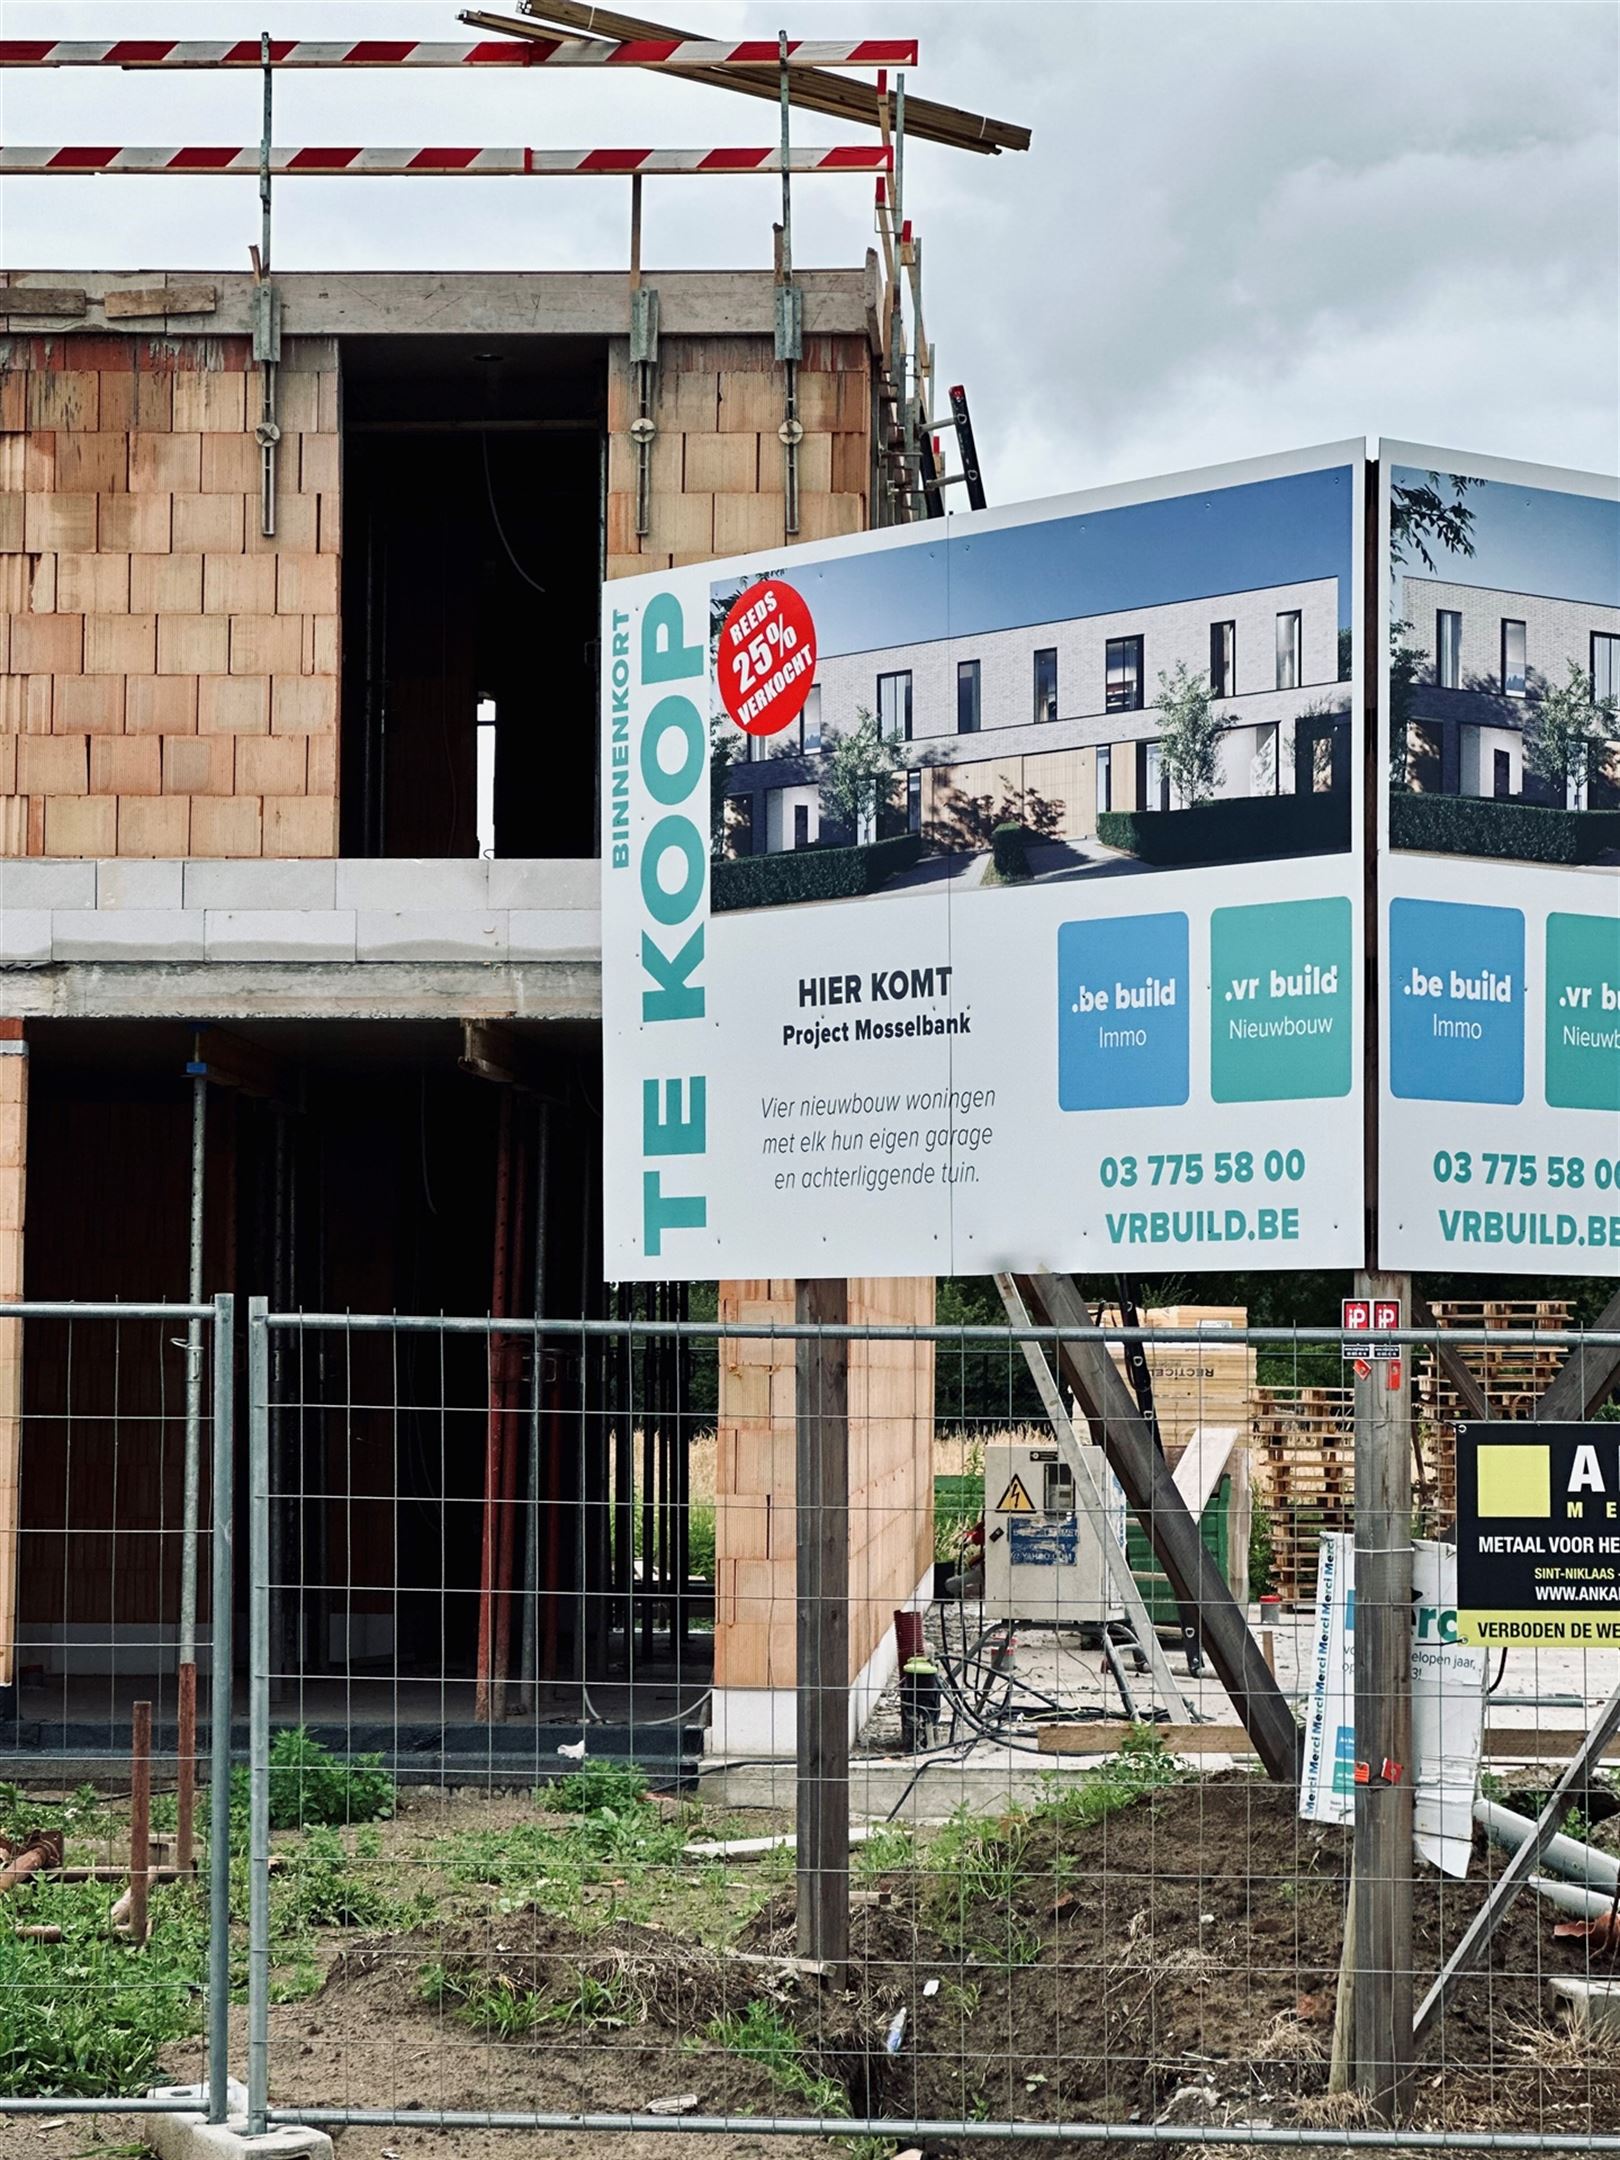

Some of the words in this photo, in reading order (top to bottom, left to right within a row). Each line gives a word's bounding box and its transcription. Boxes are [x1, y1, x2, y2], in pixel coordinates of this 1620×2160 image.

[729, 589, 778, 647] REEDS
[732, 614, 797, 696] 25%
[737, 642, 814, 726] VERKOCHT
[612, 609, 630, 870] BINNENKORT
[640, 592, 706, 1023] KOOP
[799, 974, 862, 1007] HIER
[871, 966, 952, 1001] KOMT
[1072, 985, 1109, 1013] .be
[1115, 977, 1176, 1010] build
[1225, 976, 1259, 1002] .vr
[1270, 964, 1338, 998] build
[1403, 967, 1443, 998] .be
[1450, 969, 1512, 1003] build
[1559, 986, 1592, 1009] .vr
[783, 1021, 849, 1049] Project
[855, 1012, 971, 1041] Mosselbank
[1099, 1026, 1147, 1049] Immo
[1229, 1016, 1333, 1040] Nieuwbouw
[1433, 1013, 1482, 1040] Immo
[761, 1096, 796, 1119] Vier
[800, 1093, 901, 1117] nieuwbouw
[906, 1088, 996, 1114] woningen
[762, 1132, 795, 1154] met
[800, 1130, 827, 1152] elk
[831, 1129, 863, 1151] hun
[870, 1128, 919, 1154] eigen
[925, 1127, 993, 1152] garage
[643, 1076, 707, 1257] TE
[774, 1171, 795, 1189] en
[801, 1162, 935, 1191] achterliggende
[942, 1161, 980, 1184] tuin.
[1100, 1156, 1138, 1188] 03
[1148, 1153, 1204, 1186] 775
[1214, 1151, 1254, 1184] 58
[1264, 1148, 1306, 1182] 00
[1433, 1150, 1472, 1183] 03
[1481, 1153, 1538, 1187] 775
[1547, 1156, 1585, 1189] 58
[1105, 1208, 1300, 1244] VRBUILD.BE
[1438, 1209, 1620, 1247] VRBUILD.BE
[1324, 1538, 1334, 1575] Merci
[1478, 1536, 1545, 1553] METAAL
[1548, 1536, 1595, 1553] VOOR
[1534, 1567, 1615, 1580] SINT-NIKLAAS
[1322, 1578, 1333, 1615] Merci
[1535, 1586, 1620, 1601] WWW.ANKA
[1318, 1617, 1330, 1654] Merci
[1477, 1622, 1565, 1639] VERBODEN
[1571, 1622, 1592, 1639] DE
[1315, 1657, 1327, 1695] Merci
[1453, 1655, 1476, 1670] jaar,
[1312, 1697, 1323, 1734] Merci
[1309, 1737, 1321, 1775] Merci
[1305, 1777, 1317, 1814] Merci
